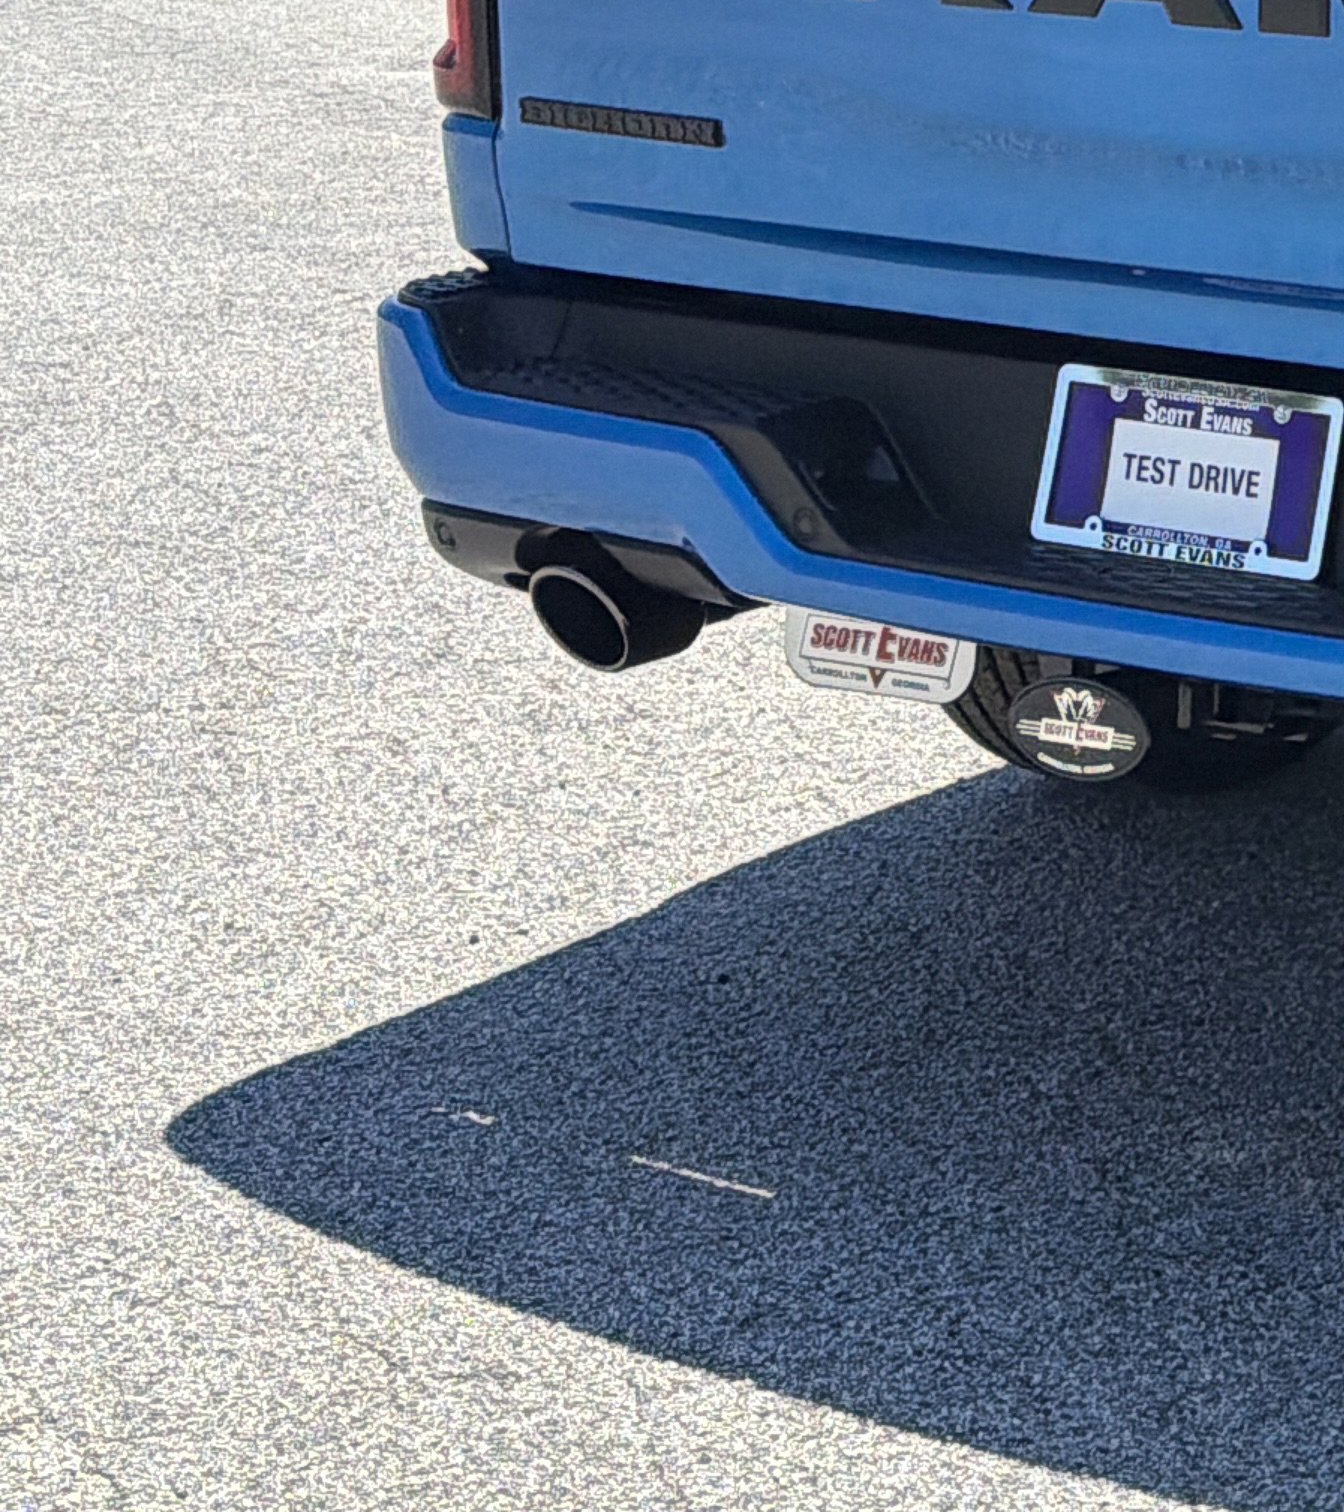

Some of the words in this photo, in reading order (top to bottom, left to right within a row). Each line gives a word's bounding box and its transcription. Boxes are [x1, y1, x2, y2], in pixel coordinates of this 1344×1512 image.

[1143, 398, 1196, 429] SCOTT
[1200, 405, 1254, 436] EVANS
[1122, 452, 1181, 487] TEST
[1188, 462, 1261, 499] DRIVE
[1101, 534, 1169, 557] SCOTT
[1174, 544, 1246, 569] EVANS
[1214, 539, 1232, 551] GA
[810, 623, 877, 656] SCOTT
[875, 626, 949, 668] EVANS
